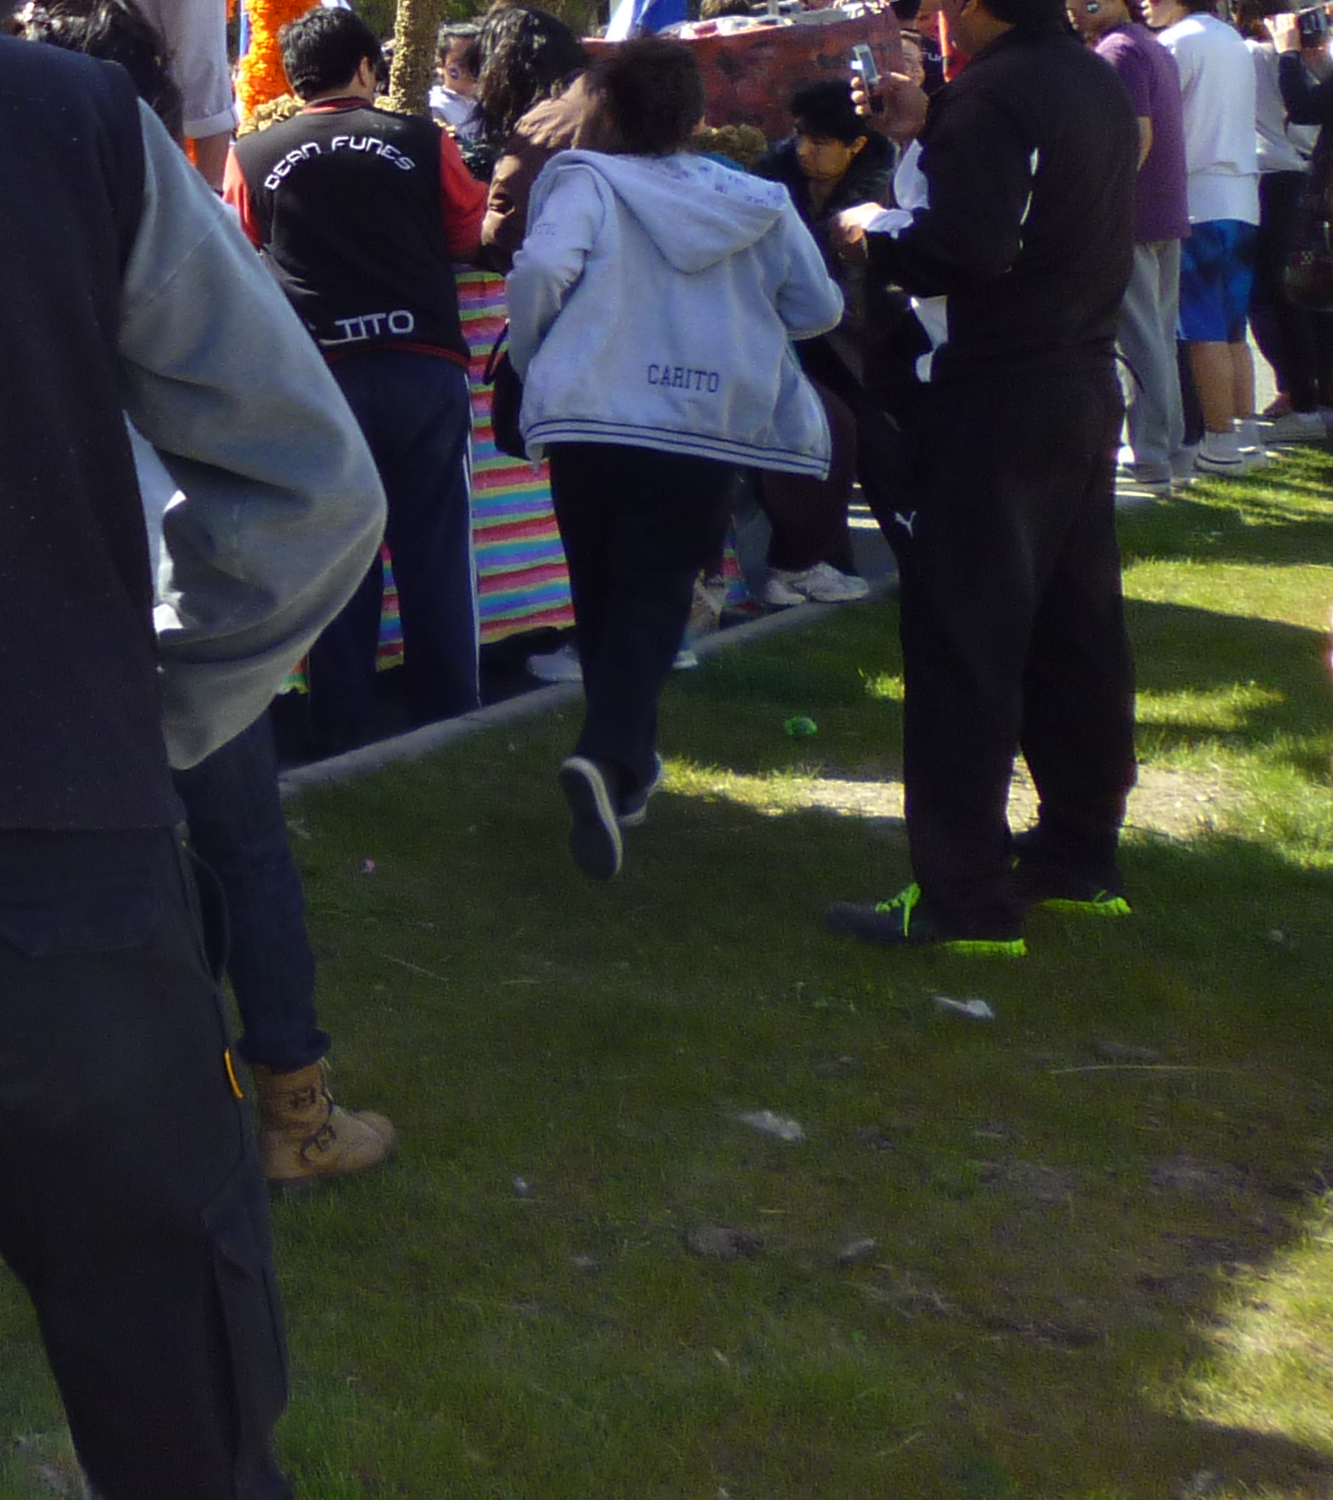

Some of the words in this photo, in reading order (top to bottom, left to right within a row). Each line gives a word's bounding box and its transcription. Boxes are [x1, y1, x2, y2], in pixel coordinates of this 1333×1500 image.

[264, 141, 322, 190] DEAN
[331, 135, 415, 171] FUNES
[647, 363, 720, 394] CARITO
